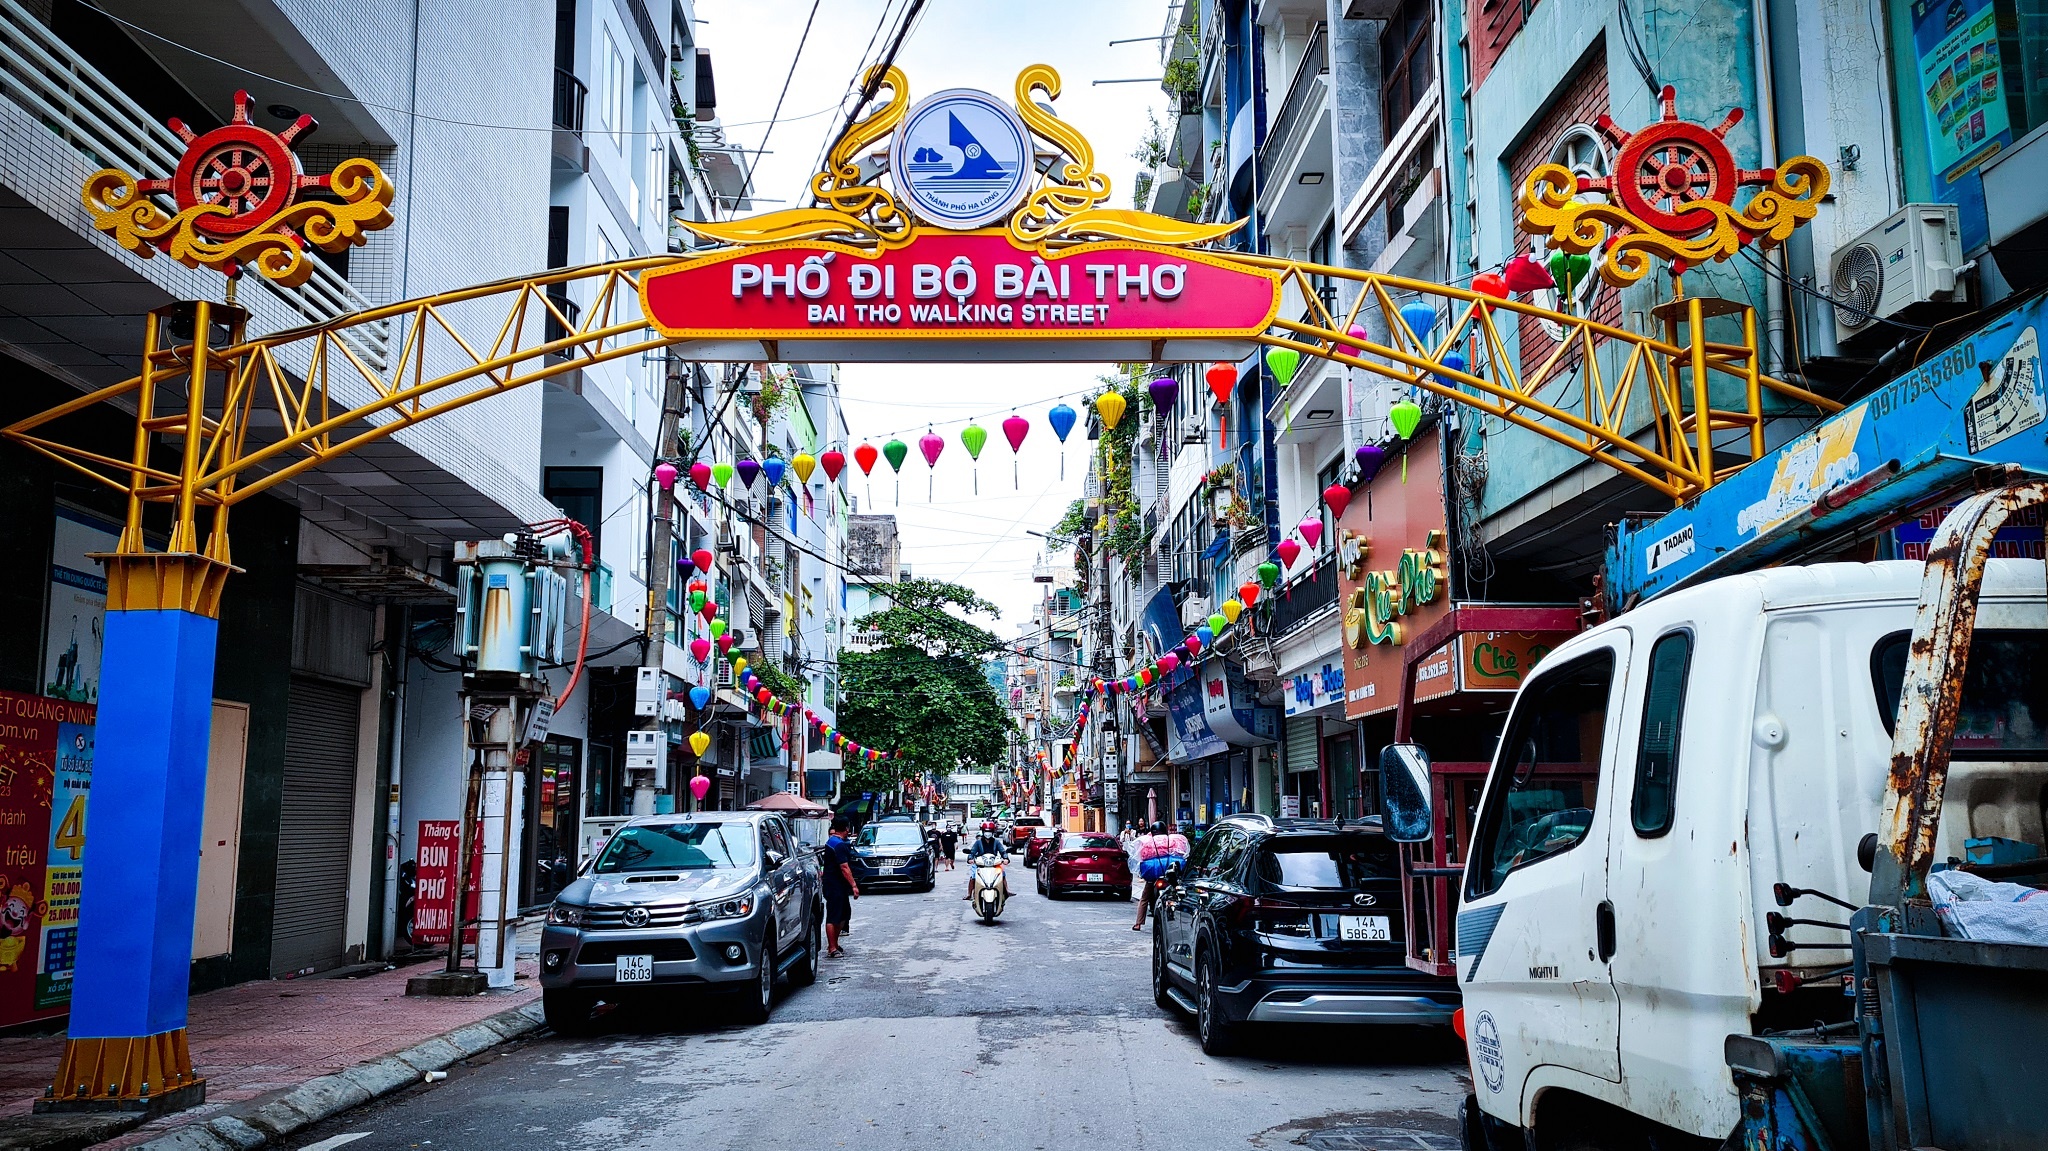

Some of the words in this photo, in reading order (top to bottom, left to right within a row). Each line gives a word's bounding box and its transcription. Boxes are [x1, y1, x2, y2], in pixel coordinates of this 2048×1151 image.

[925, 191, 949, 209] THÀNH
[950, 201, 967, 211] PHỐ
[968, 202, 980, 211] HẠ
[980, 191, 1000, 207] LONG
[732, 252, 837, 299] PHỐ
[847, 264, 895, 299] ĐI
[912, 256, 977, 305] BỘ
[994, 256, 1070, 299] BÀI
[1086, 264, 1188, 299] THƠ
[807, 304, 846, 324] BAI
[854, 304, 902, 324] THO
[909, 304, 1013, 323] WALKING
[1021, 304, 1110, 325] STREET
[1870, 342, 1976, 421] 0977555860
[1663, 527, 1693, 552] TADANO
[1364, 570, 1402, 647] Chè
[1396, 529, 1447, 617] Phố
[1473, 642, 1519, 682] Chè
[15, 698, 65, 722] QUẢNG
[54, 794, 86, 861] 4
[424, 822, 451, 840] Thắng
[6, 845, 37, 870] triệu
[420, 842, 449, 867] BÚN
[418, 869, 447, 899] PHỞ
[1346, 928, 1386, 940] 586.20
[1356, 917, 1376, 928] 14A
[618, 968, 651, 981] 166.03
[626, 956, 644, 969] 14C
[1529, 966, 1553, 979] MIGHTY
